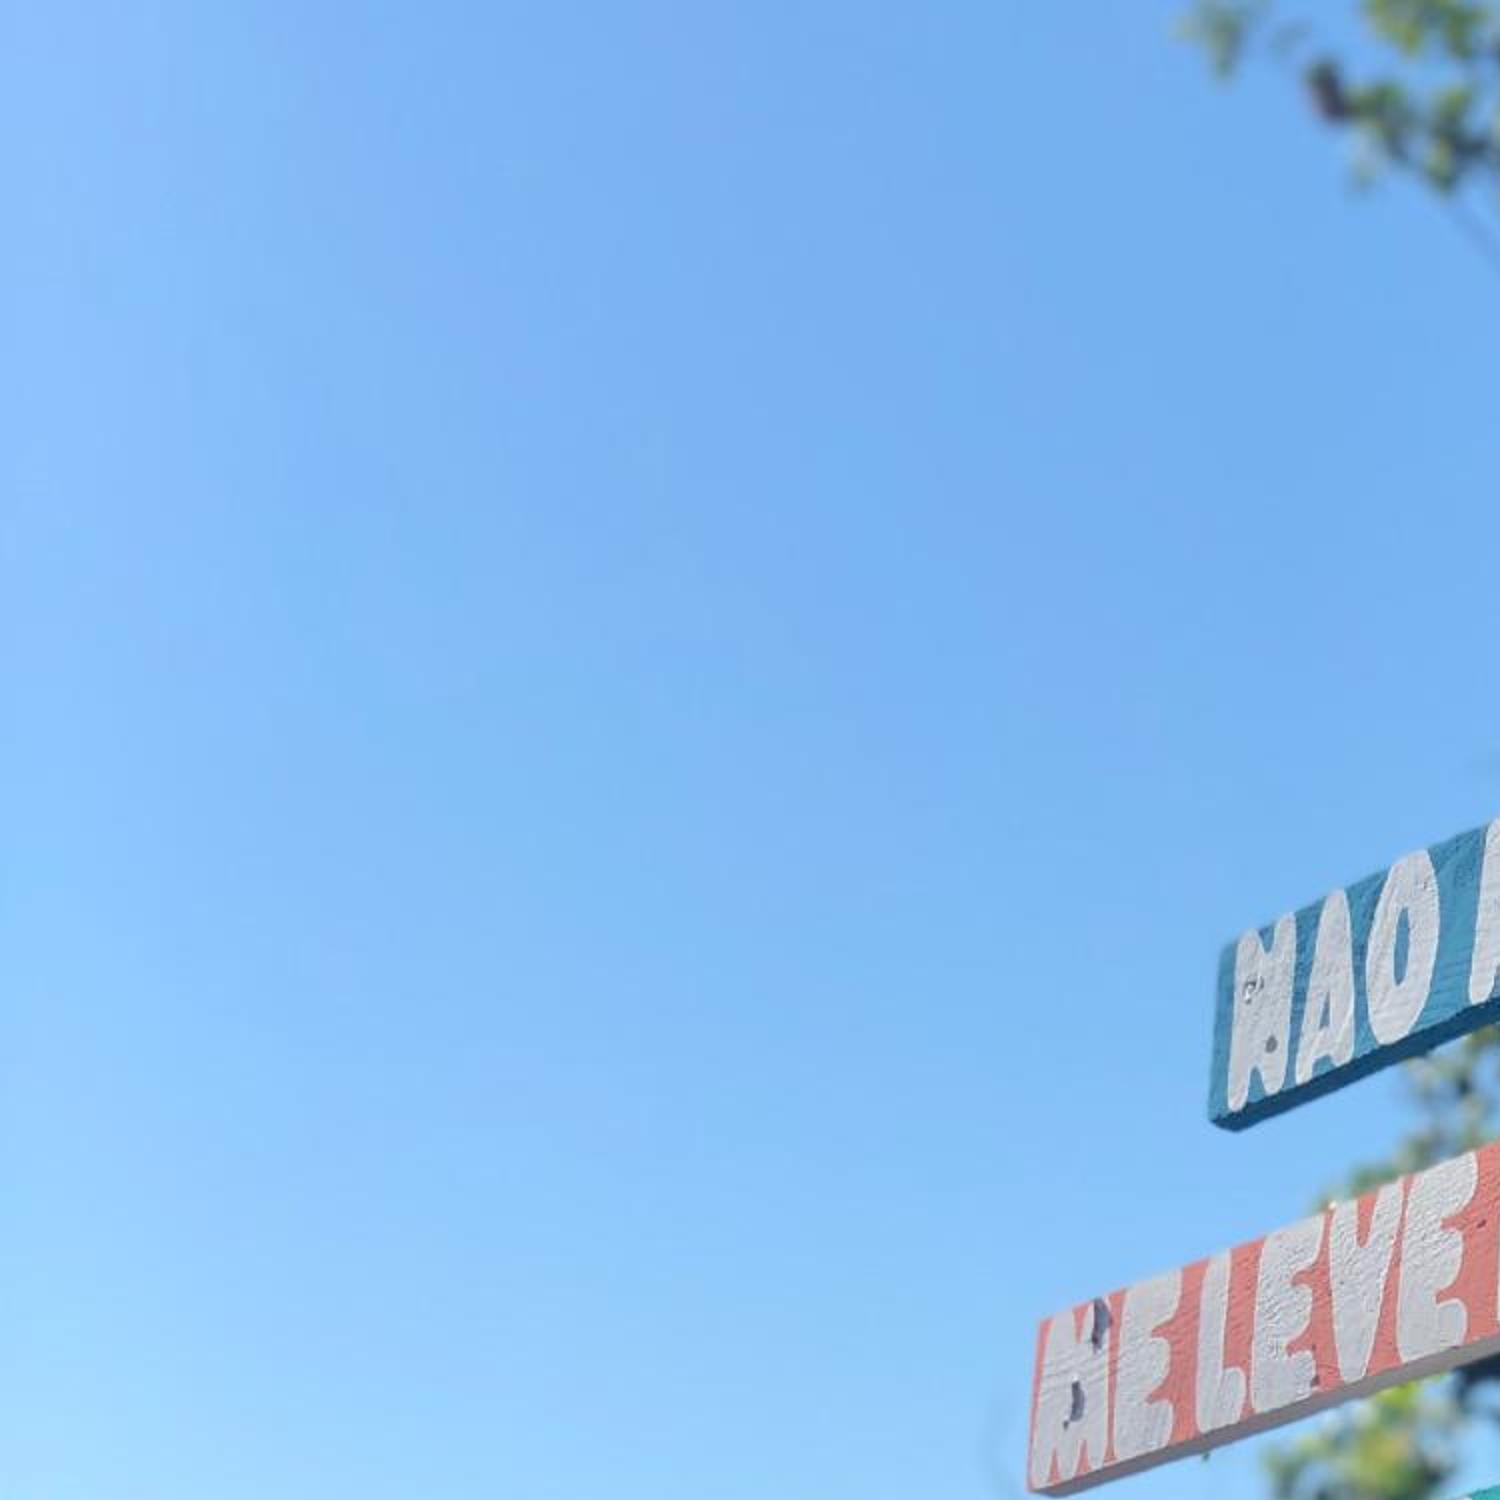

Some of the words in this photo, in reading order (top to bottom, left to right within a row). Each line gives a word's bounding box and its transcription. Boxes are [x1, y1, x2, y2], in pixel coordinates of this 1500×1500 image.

[1226, 848, 1440, 1112] NAO
[1031, 1268, 1184, 1488] ME
[1195, 1152, 1478, 1432] LEVE
